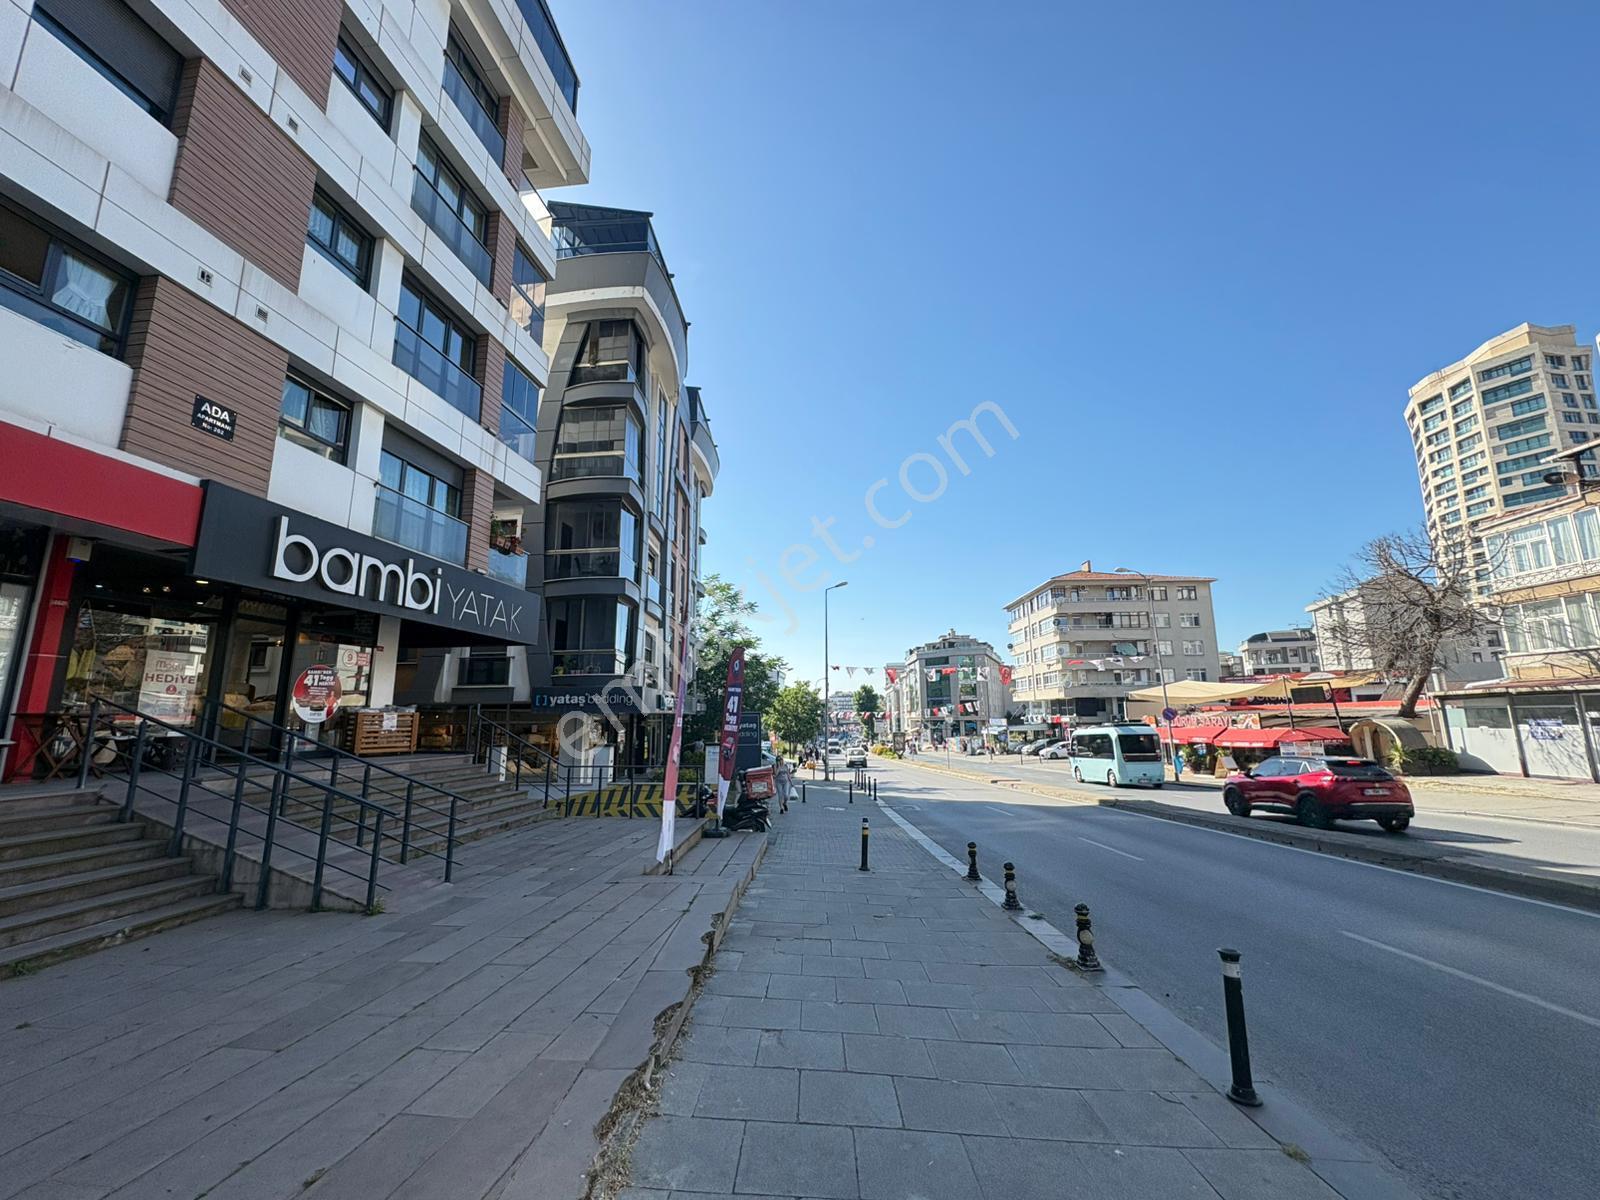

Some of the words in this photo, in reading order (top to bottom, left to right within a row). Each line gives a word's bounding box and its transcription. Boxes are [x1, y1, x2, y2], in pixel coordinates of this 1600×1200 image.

[201, 402, 230, 423] ADA
[271, 515, 443, 615] bambi
[446, 583, 523, 634] YATAK
[303, 675, 319, 686] 41
[549, 693, 587, 707] yataş
[727, 695, 739, 713] 41
